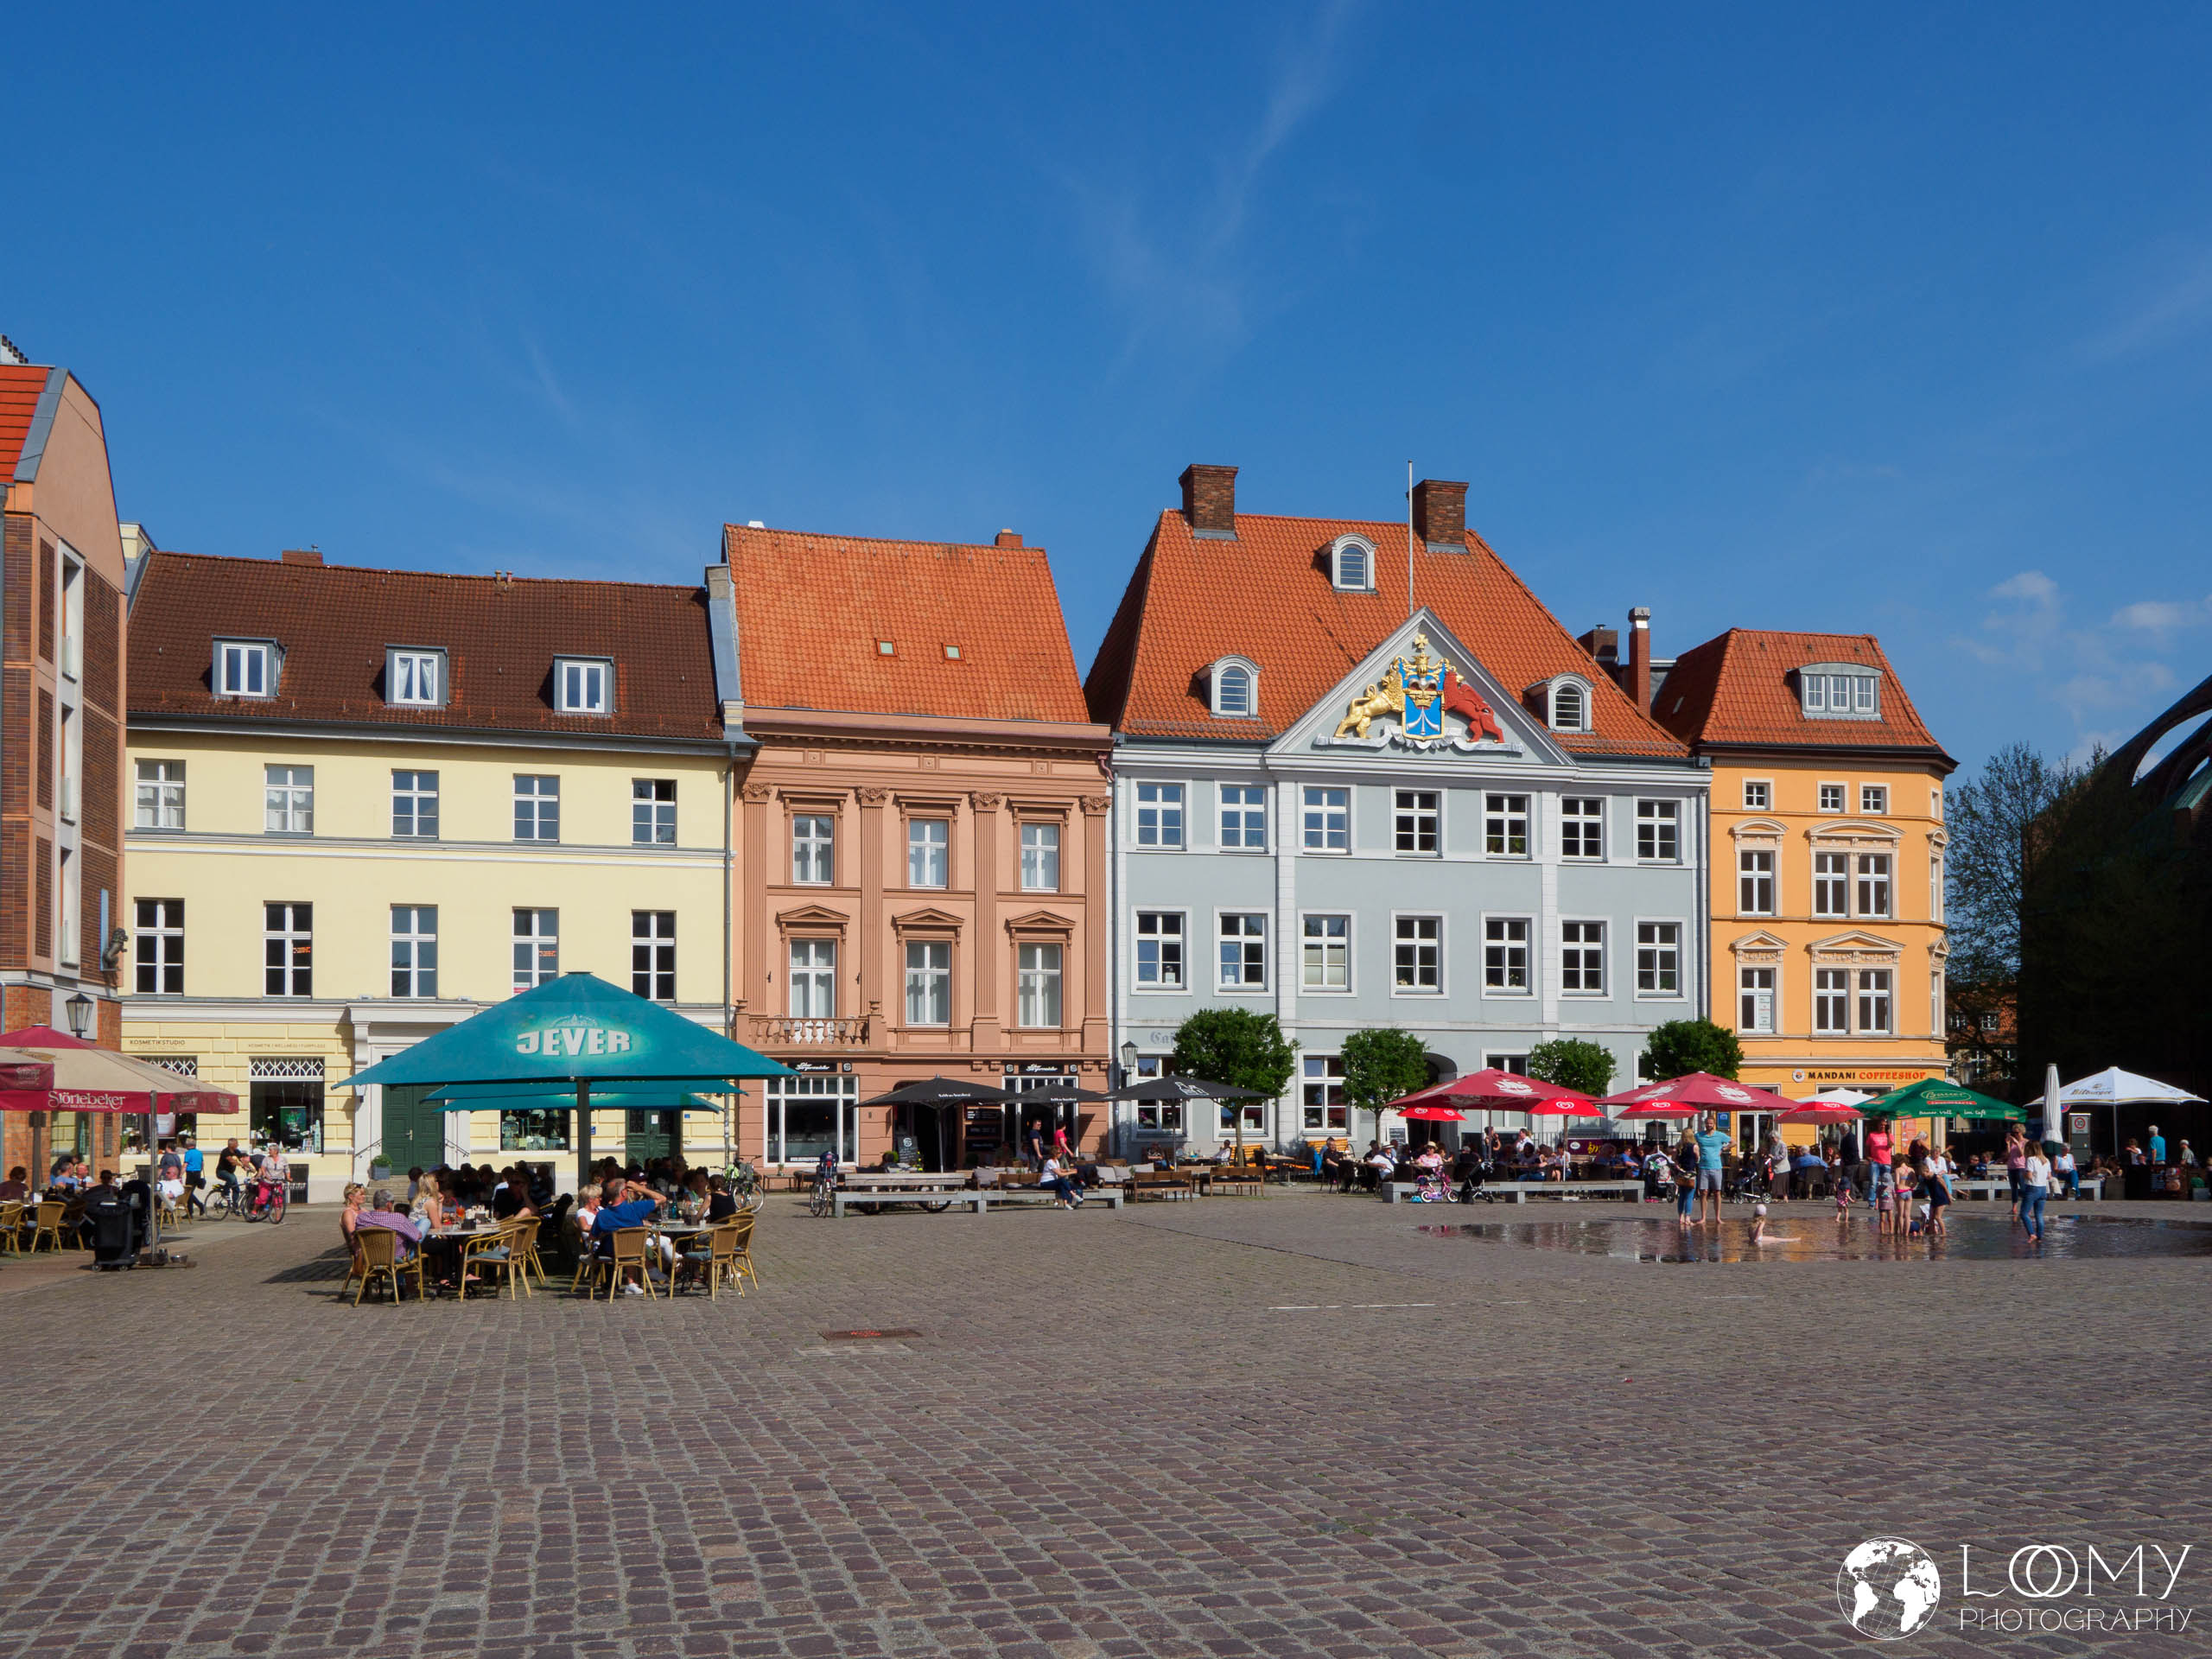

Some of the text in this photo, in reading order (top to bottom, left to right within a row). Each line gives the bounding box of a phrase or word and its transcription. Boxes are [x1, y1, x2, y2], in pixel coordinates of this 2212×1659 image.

[516, 1027, 630, 1056] JEVER
[1150, 1031, 1176, 1047] Caf
[48, 1090, 126, 1109] Störtebeker
